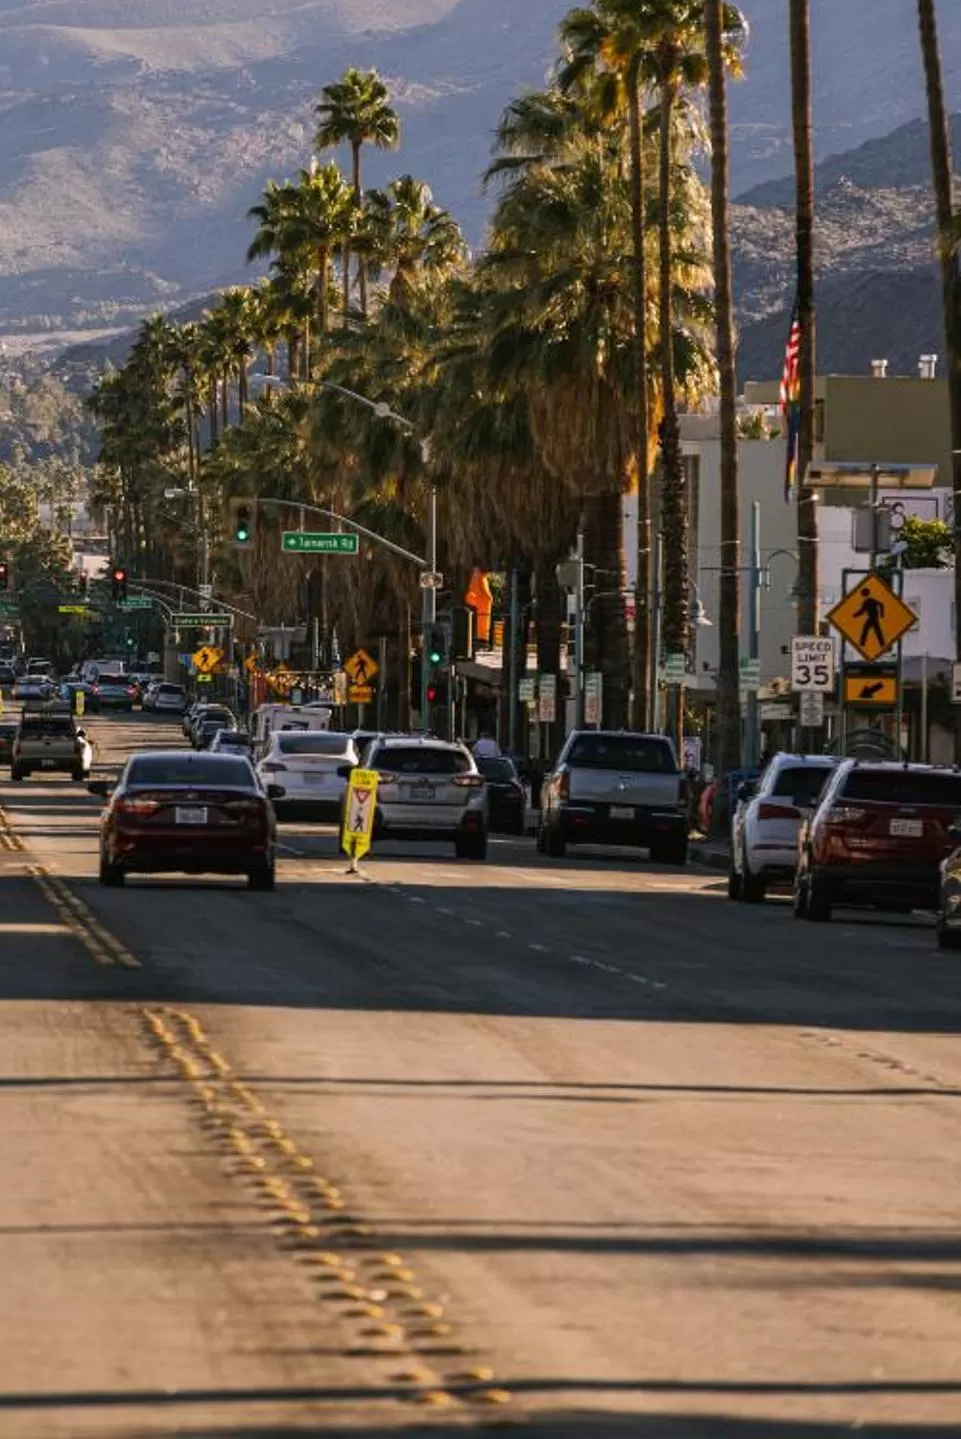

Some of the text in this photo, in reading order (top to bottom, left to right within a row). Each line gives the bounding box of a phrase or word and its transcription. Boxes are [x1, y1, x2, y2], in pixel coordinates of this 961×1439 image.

[794, 641, 831, 651] SPEED
[797, 653, 827, 662] LIMIT
[795, 665, 829, 685] 35
